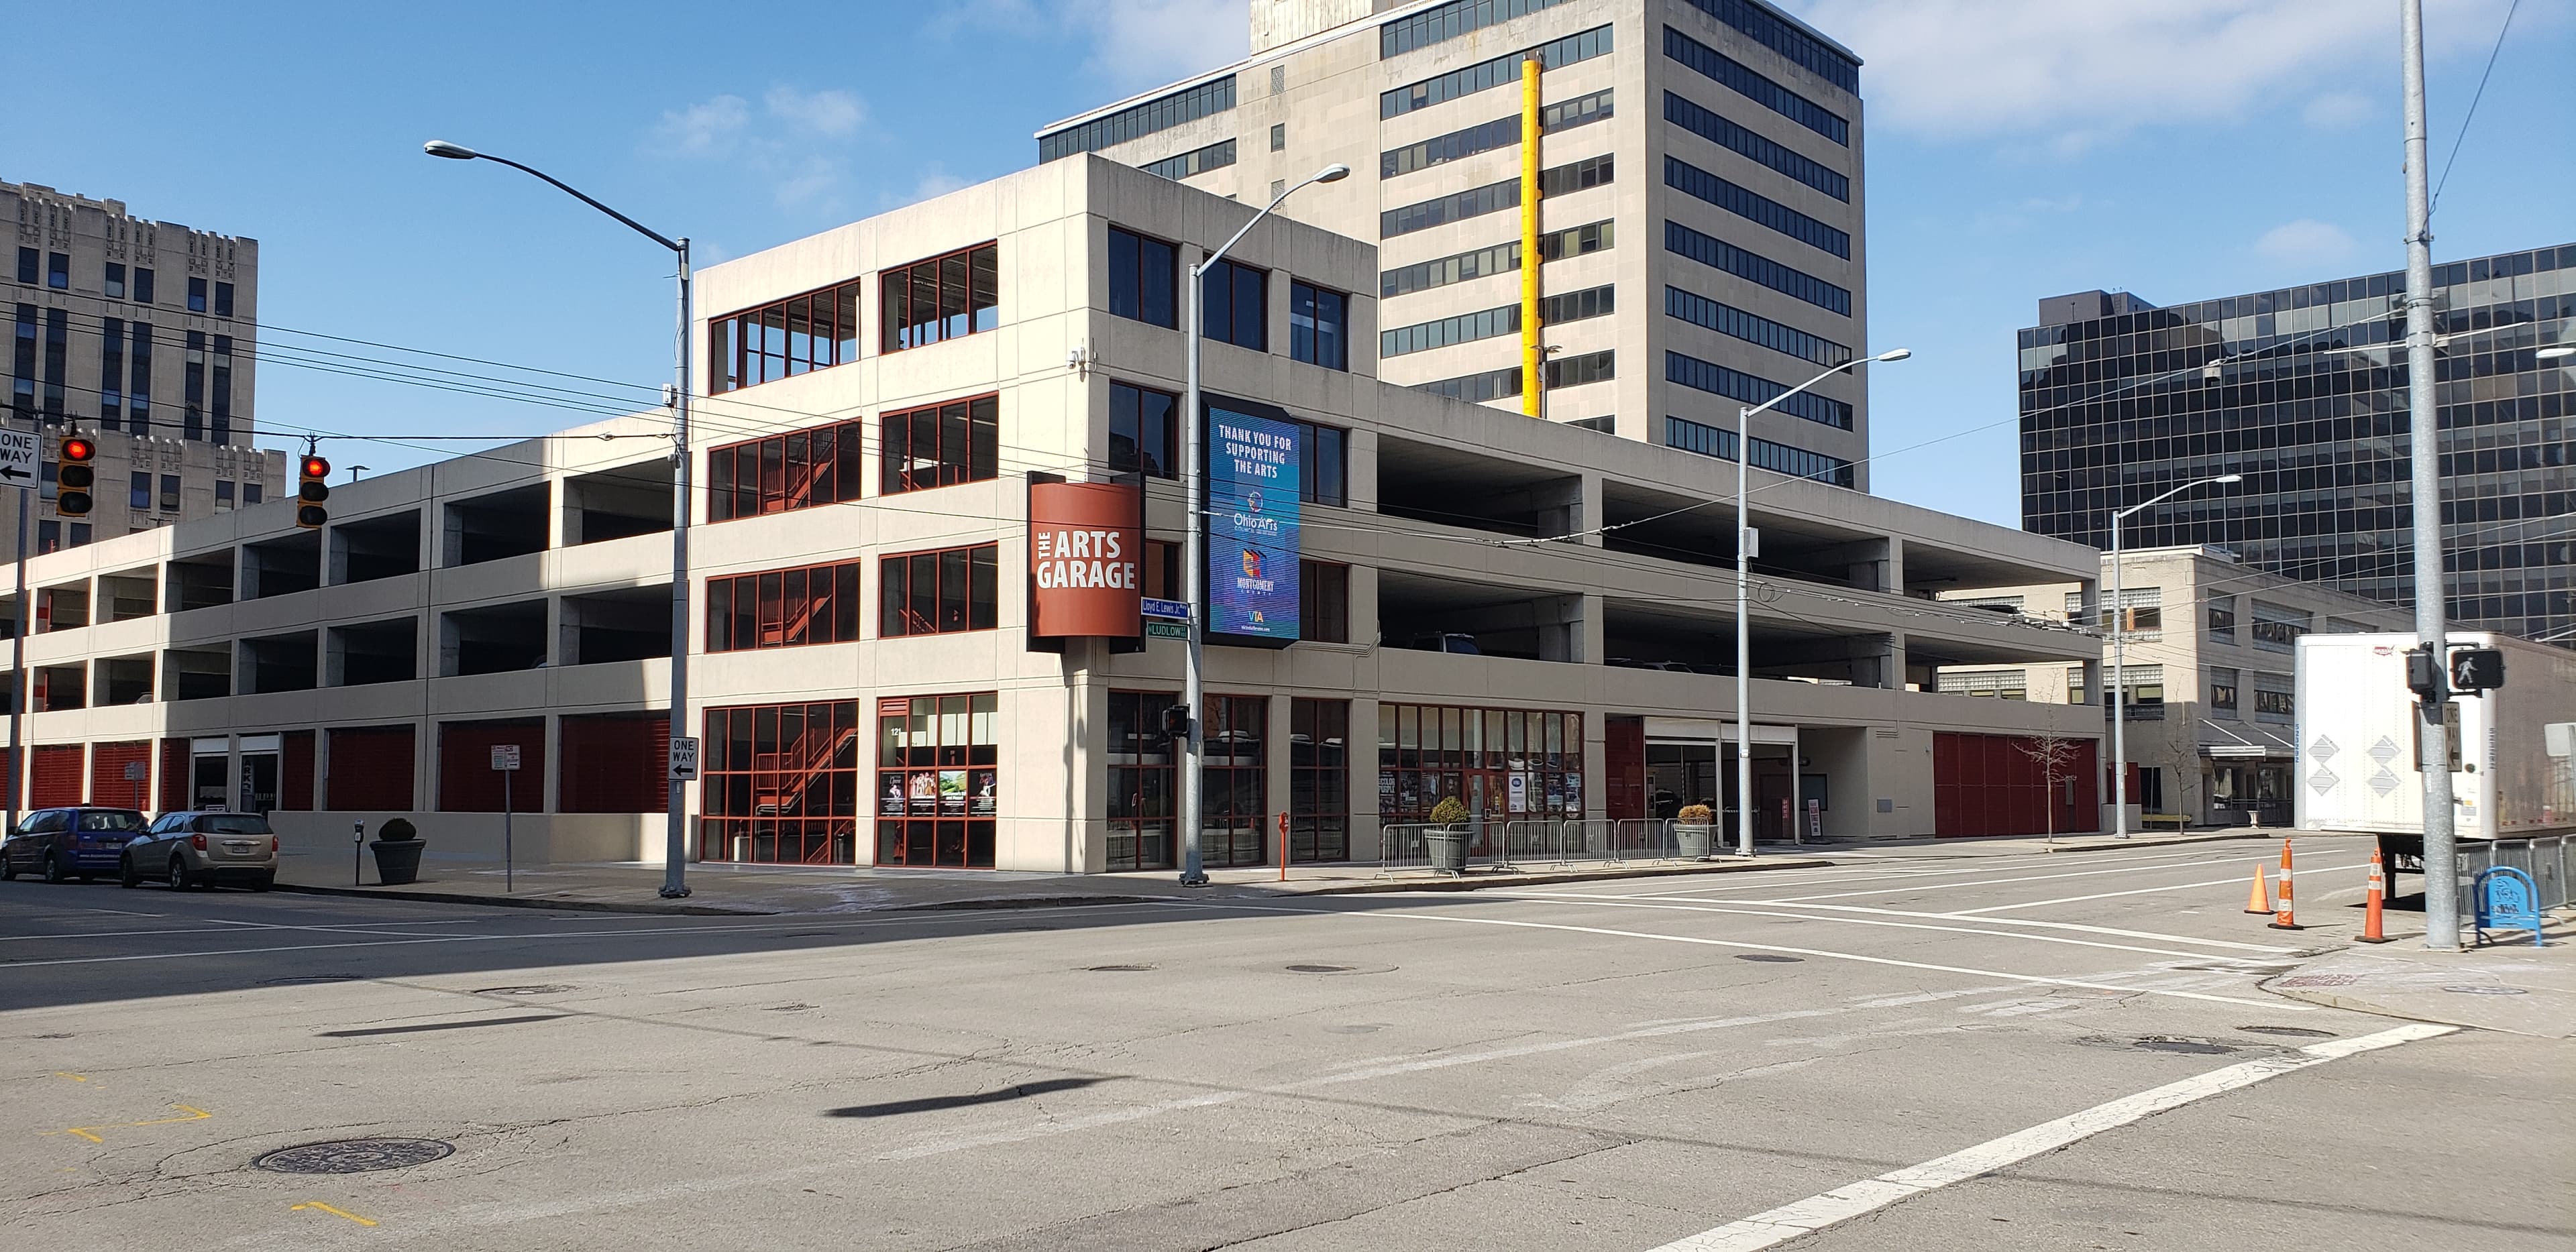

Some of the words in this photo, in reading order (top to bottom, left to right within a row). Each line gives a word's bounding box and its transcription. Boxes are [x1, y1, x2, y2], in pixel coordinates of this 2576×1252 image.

[1, 434, 32, 449] ONE
[1219, 424, 1251, 443] THANK
[1253, 431, 1271, 447] YOU
[1274, 435, 1291, 451] FOR
[0, 448, 32, 463] WAY
[1226, 442, 1285, 465] SUPPORTING
[1234, 459, 1252, 474] THE
[1254, 463, 1277, 478] ARTS
[1234, 513, 1256, 528] Ohio
[1258, 516, 1278, 531] Arts
[1038, 532, 1051, 559] THE
[1054, 530, 1121, 559] ARTS
[1036, 561, 1135, 589] GARAGE
[1143, 600, 1155, 613] Lloyd
[1161, 602, 1174, 613] Lewis
[1152, 625, 1181, 636] LUDLOW
[891, 728, 902, 736] 121
[674, 740, 694, 750] ONE
[673, 752, 694, 762] WAY
